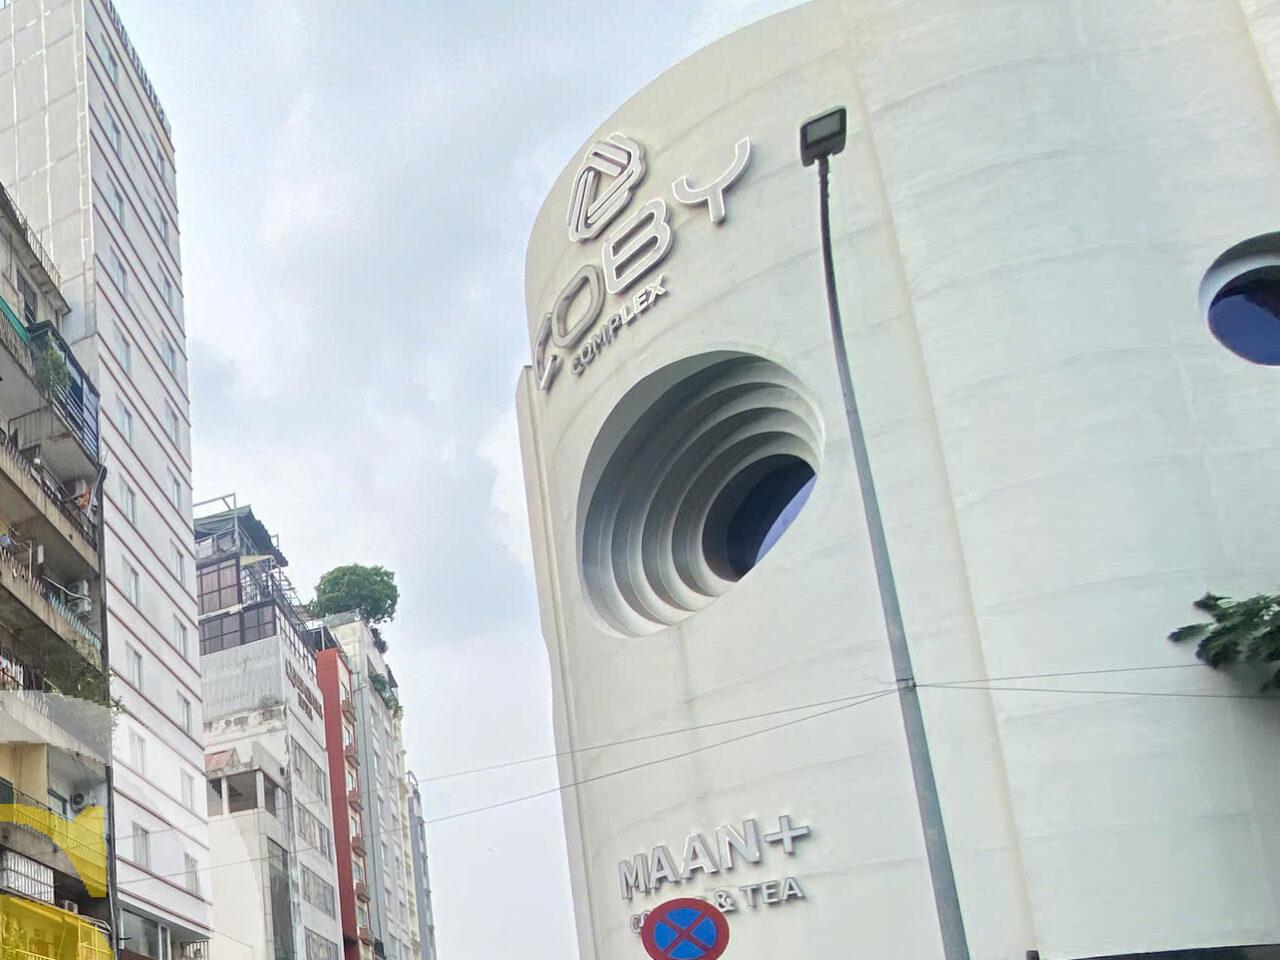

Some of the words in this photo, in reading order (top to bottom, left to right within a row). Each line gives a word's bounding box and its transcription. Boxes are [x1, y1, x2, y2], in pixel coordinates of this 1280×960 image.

[571, 275, 669, 376] COMPLEX
[618, 815, 810, 900] MAAN+
[740, 876, 806, 907] TEA
